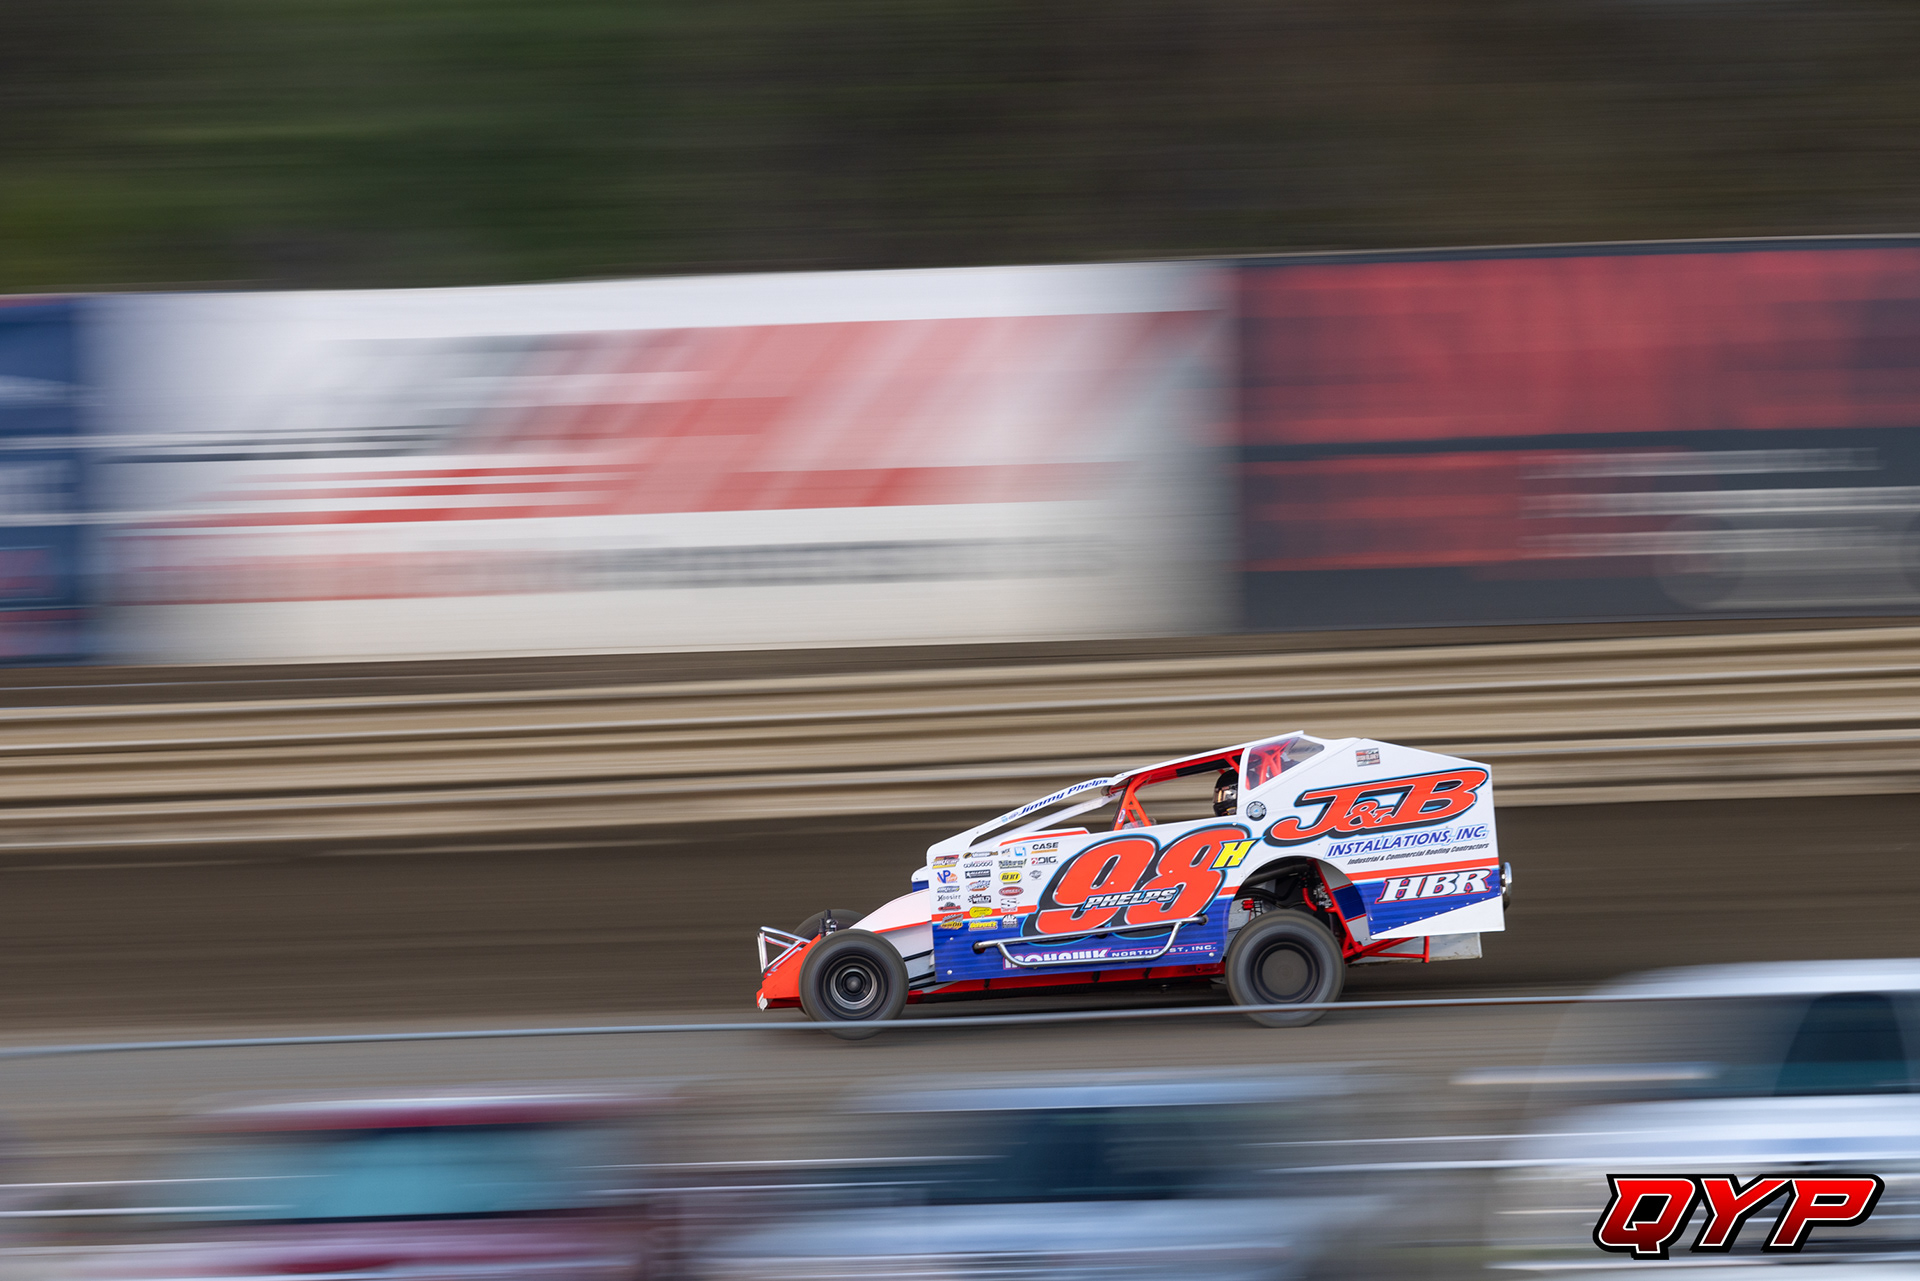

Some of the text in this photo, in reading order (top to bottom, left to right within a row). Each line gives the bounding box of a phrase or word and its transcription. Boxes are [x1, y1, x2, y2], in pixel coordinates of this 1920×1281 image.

[1020, 779, 1108, 814] Jimmy Phelps
[1266, 769, 1488, 844] J&B
[1032, 842, 1059, 850] CASE
[1327, 825, 1486, 857] INSTALLATIONS, INC.
[1347, 855, 1380, 866] Industrial
[1385, 849, 1426, 861] Commercial
[1425, 846, 1451, 856] Roofing
[1450, 842, 1490, 853] Contractors
[937, 870, 951, 884] VP
[1376, 869, 1492, 903] HBR
[1083, 887, 1179, 911] PHELPS
[1191, 944, 1216, 952] INC.
